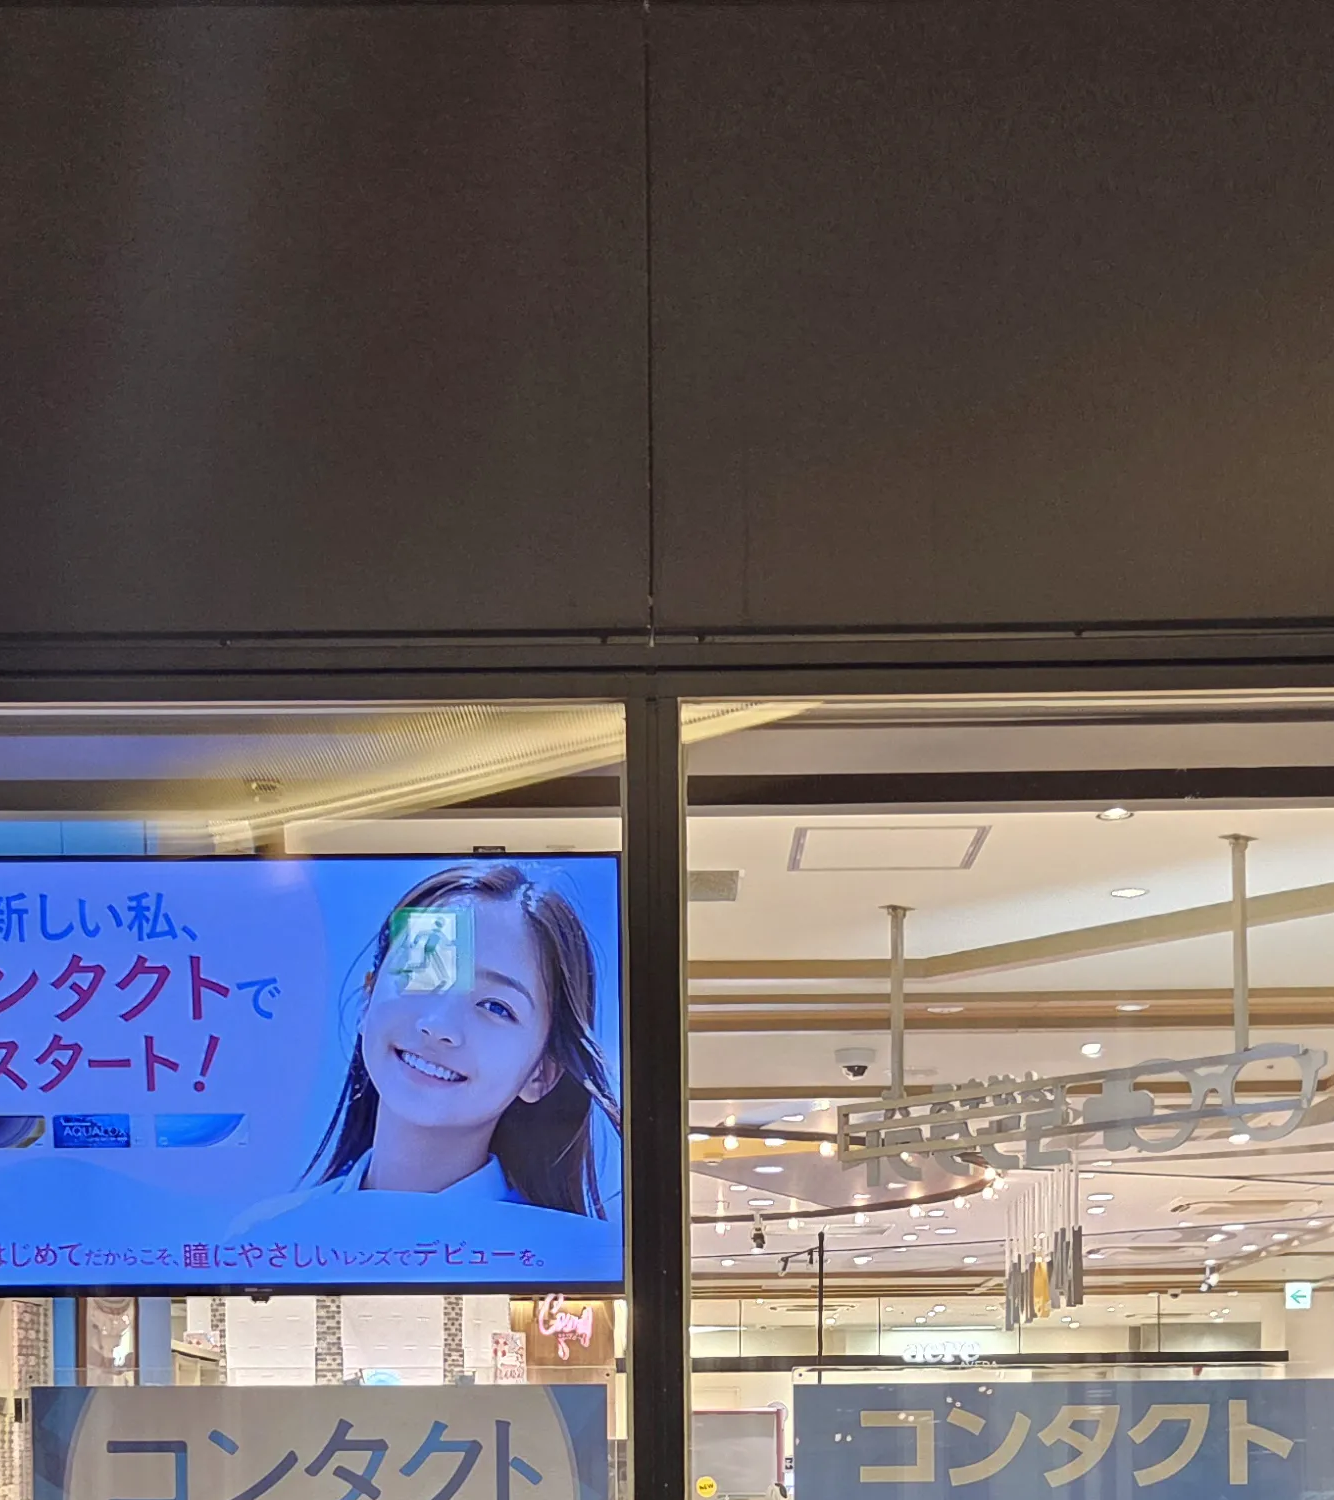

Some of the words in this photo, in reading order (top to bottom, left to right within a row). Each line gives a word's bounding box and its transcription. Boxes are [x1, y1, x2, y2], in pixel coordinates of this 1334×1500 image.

[858, 1399, 1295, 1489] コンタクト
